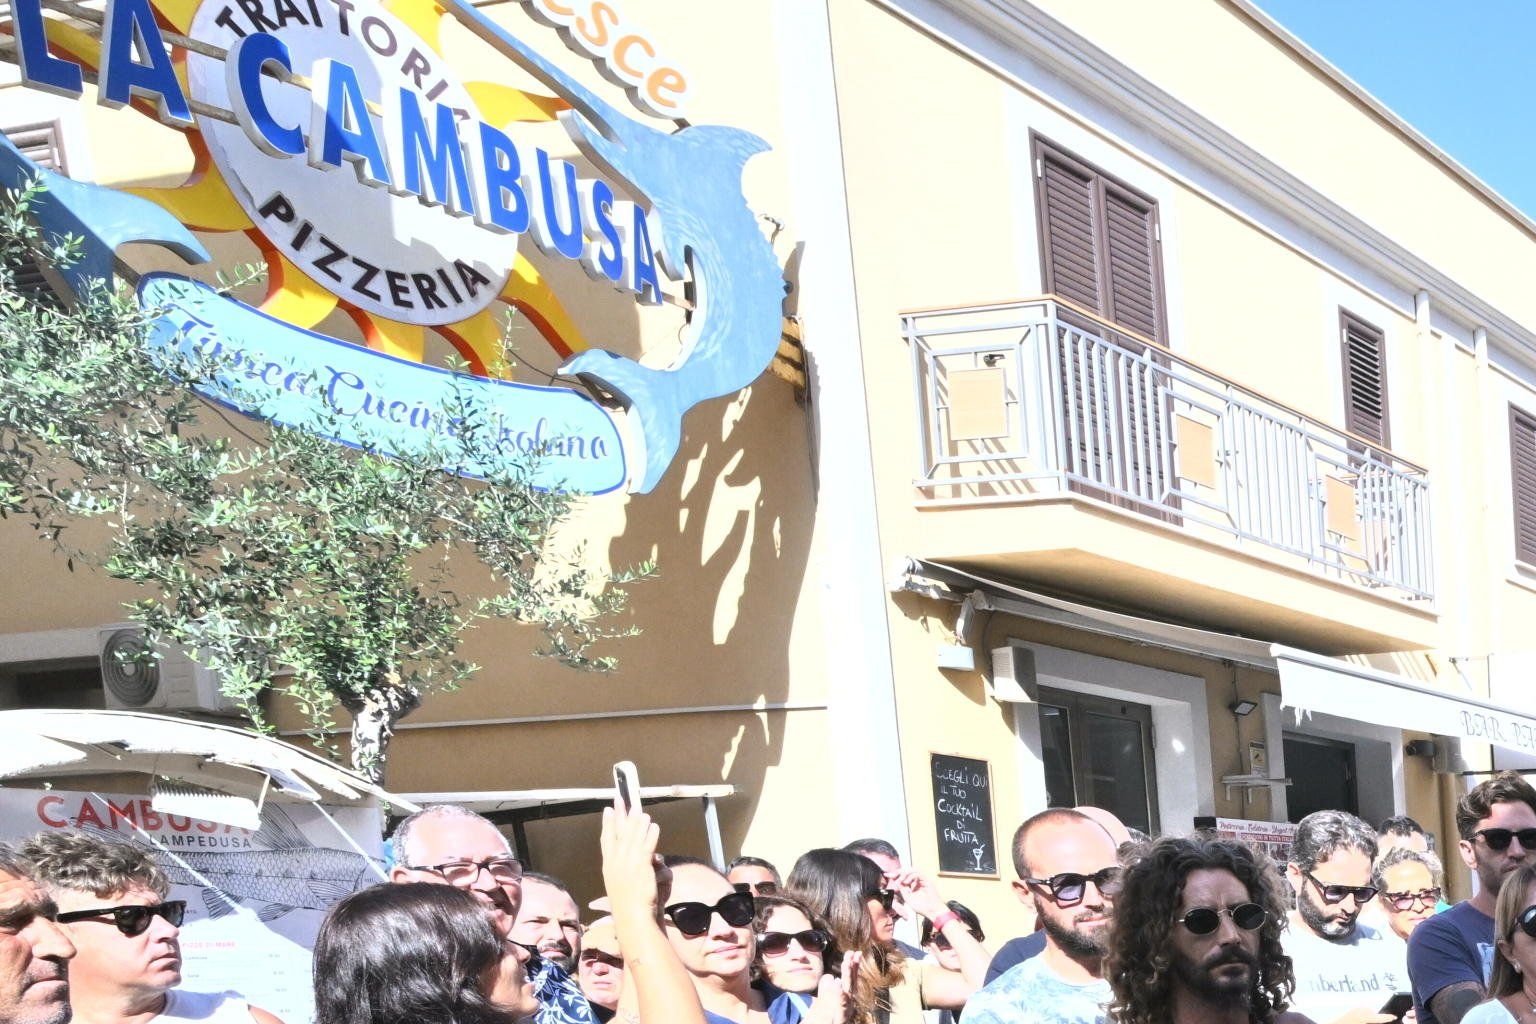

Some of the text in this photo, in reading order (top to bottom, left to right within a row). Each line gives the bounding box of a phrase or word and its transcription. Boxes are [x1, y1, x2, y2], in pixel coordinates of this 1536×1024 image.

[214, 0, 471, 122] TRATTORI
[12, 0, 664, 305] LA CAMBUSA
[258, 192, 490, 311] PIZZERIA
[1460, 710, 1507, 742] BAR
[150, 835, 251, 849] LAMPEDUSA
